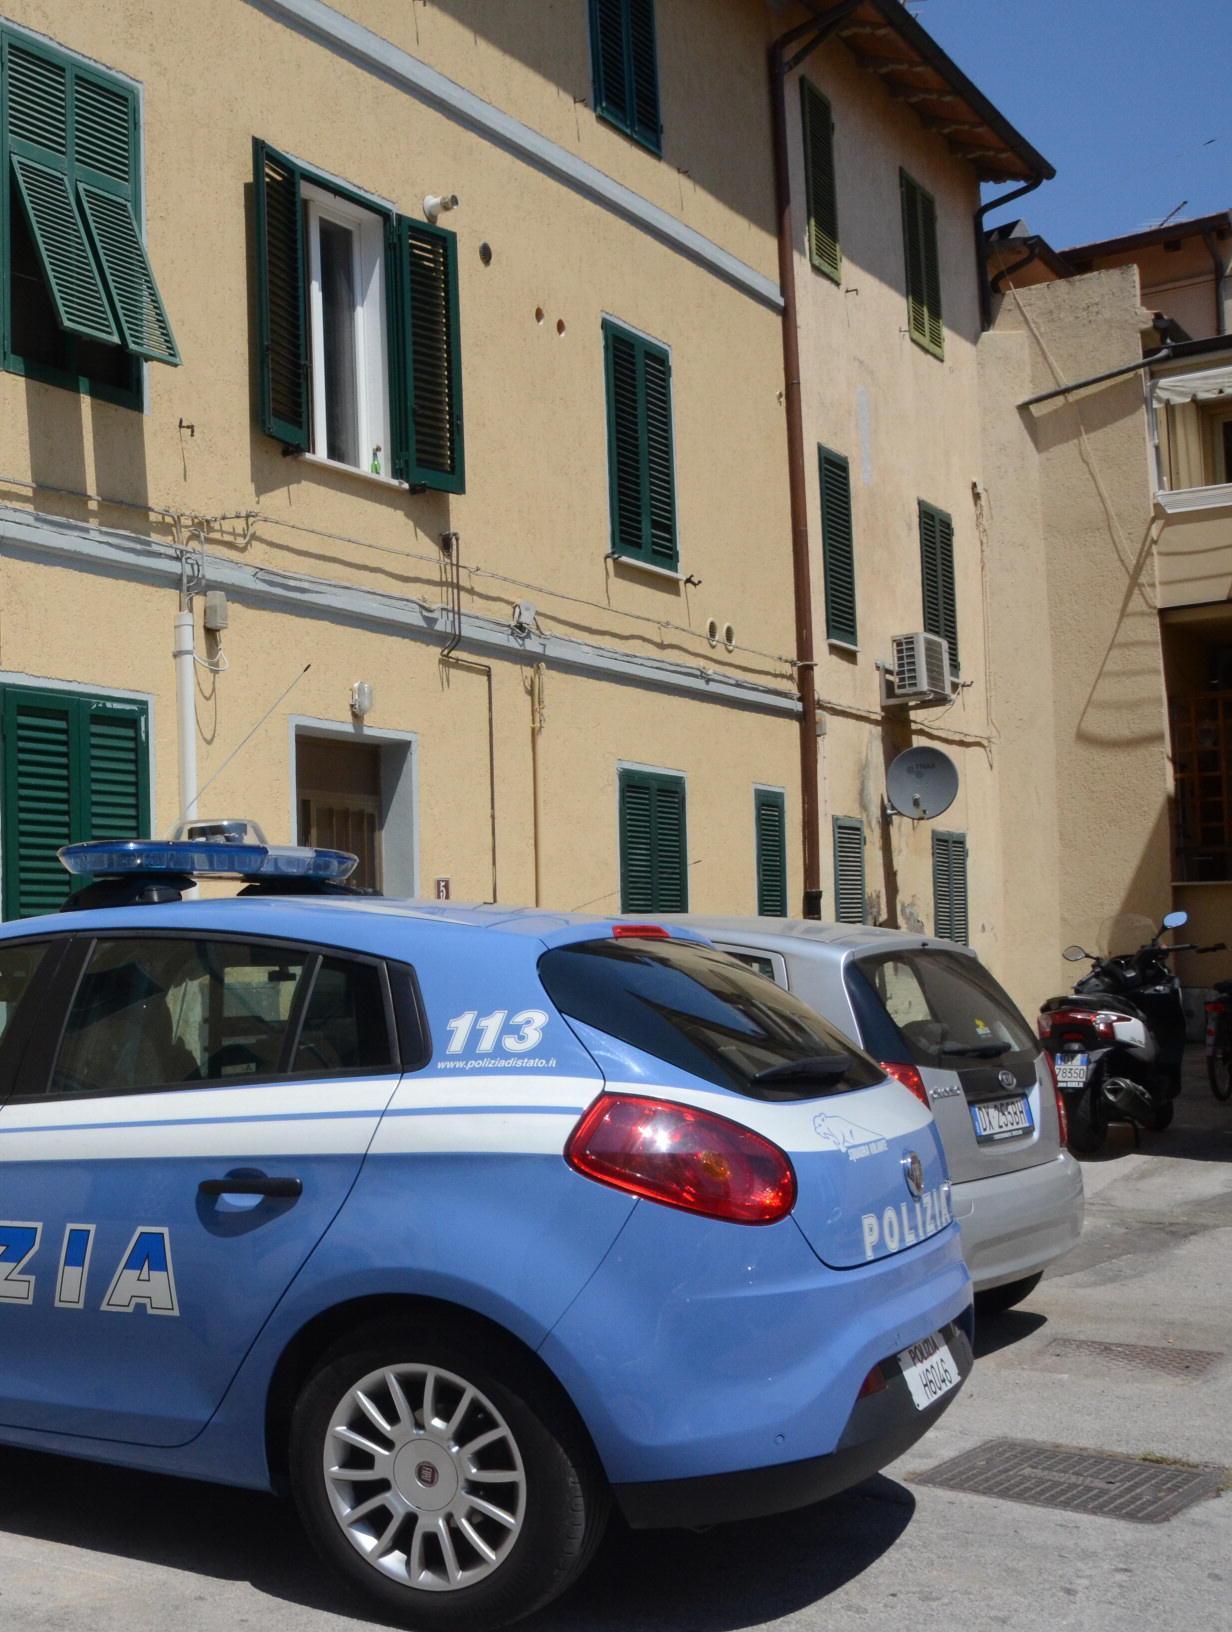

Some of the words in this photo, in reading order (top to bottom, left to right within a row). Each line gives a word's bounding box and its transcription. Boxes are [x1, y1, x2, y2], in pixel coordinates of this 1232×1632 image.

[446, 1010, 549, 1054] 113
[437, 1057, 556, 1070] www.poliziadistato.it
[862, 1183, 951, 1260] POLIZIA
